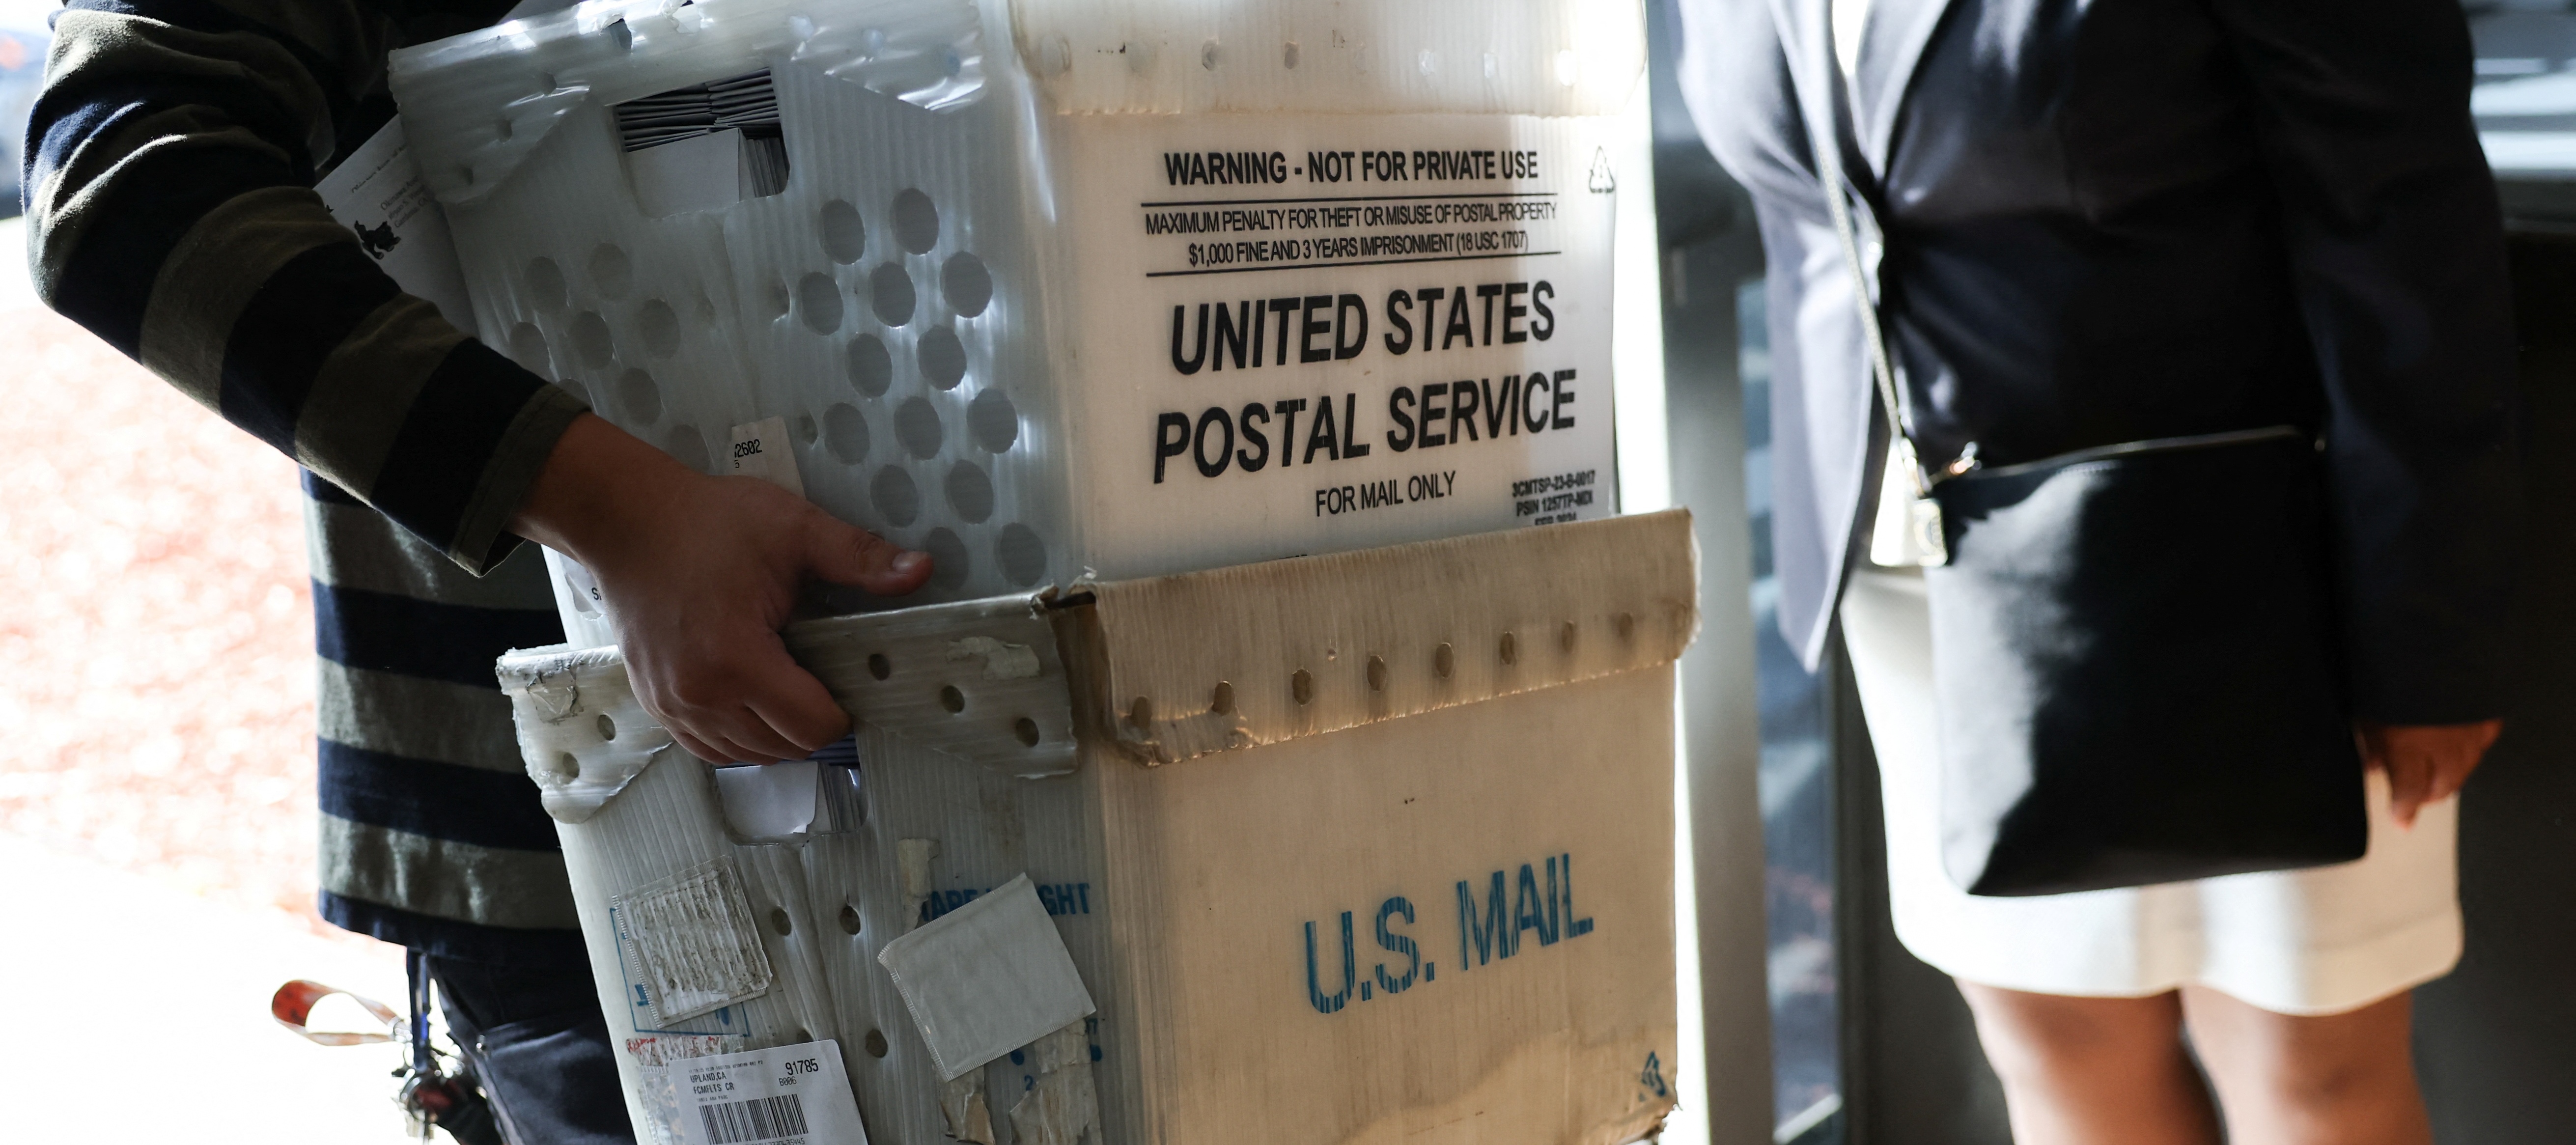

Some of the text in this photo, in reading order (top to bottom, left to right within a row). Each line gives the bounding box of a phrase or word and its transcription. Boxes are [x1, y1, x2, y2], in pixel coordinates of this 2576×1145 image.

[1164, 151, 1287, 185] WARNING
[1308, 151, 1355, 183] NOT
[1362, 151, 1408, 181] FOR
[1413, 150, 1495, 180] PRIVATE
[1502, 151, 1538, 179] USE
[1146, 202, 1557, 234] MAXIMUM PENALTY FOR THEFT OR MISUSE OF POSTAL PROPERTY
[1189, 230, 1528, 267] $1,000 FINE AND 3 YEARS IMPRISONMENT (18 USC 1707)
[1171, 281, 1554, 375] UNITED STATES
[1153, 369, 1576, 484] POSTAL SERVICE
[734, 439, 762, 458] 2602
[1316, 470, 1456, 517] FOR MAIL ONLY
[1305, 853, 1594, 1014] U.S. MAIL
[690, 1071, 727, 1083] UPLAND,CA
[785, 1058, 818, 1075] 91785
[725, 1082, 734, 1091] CR
